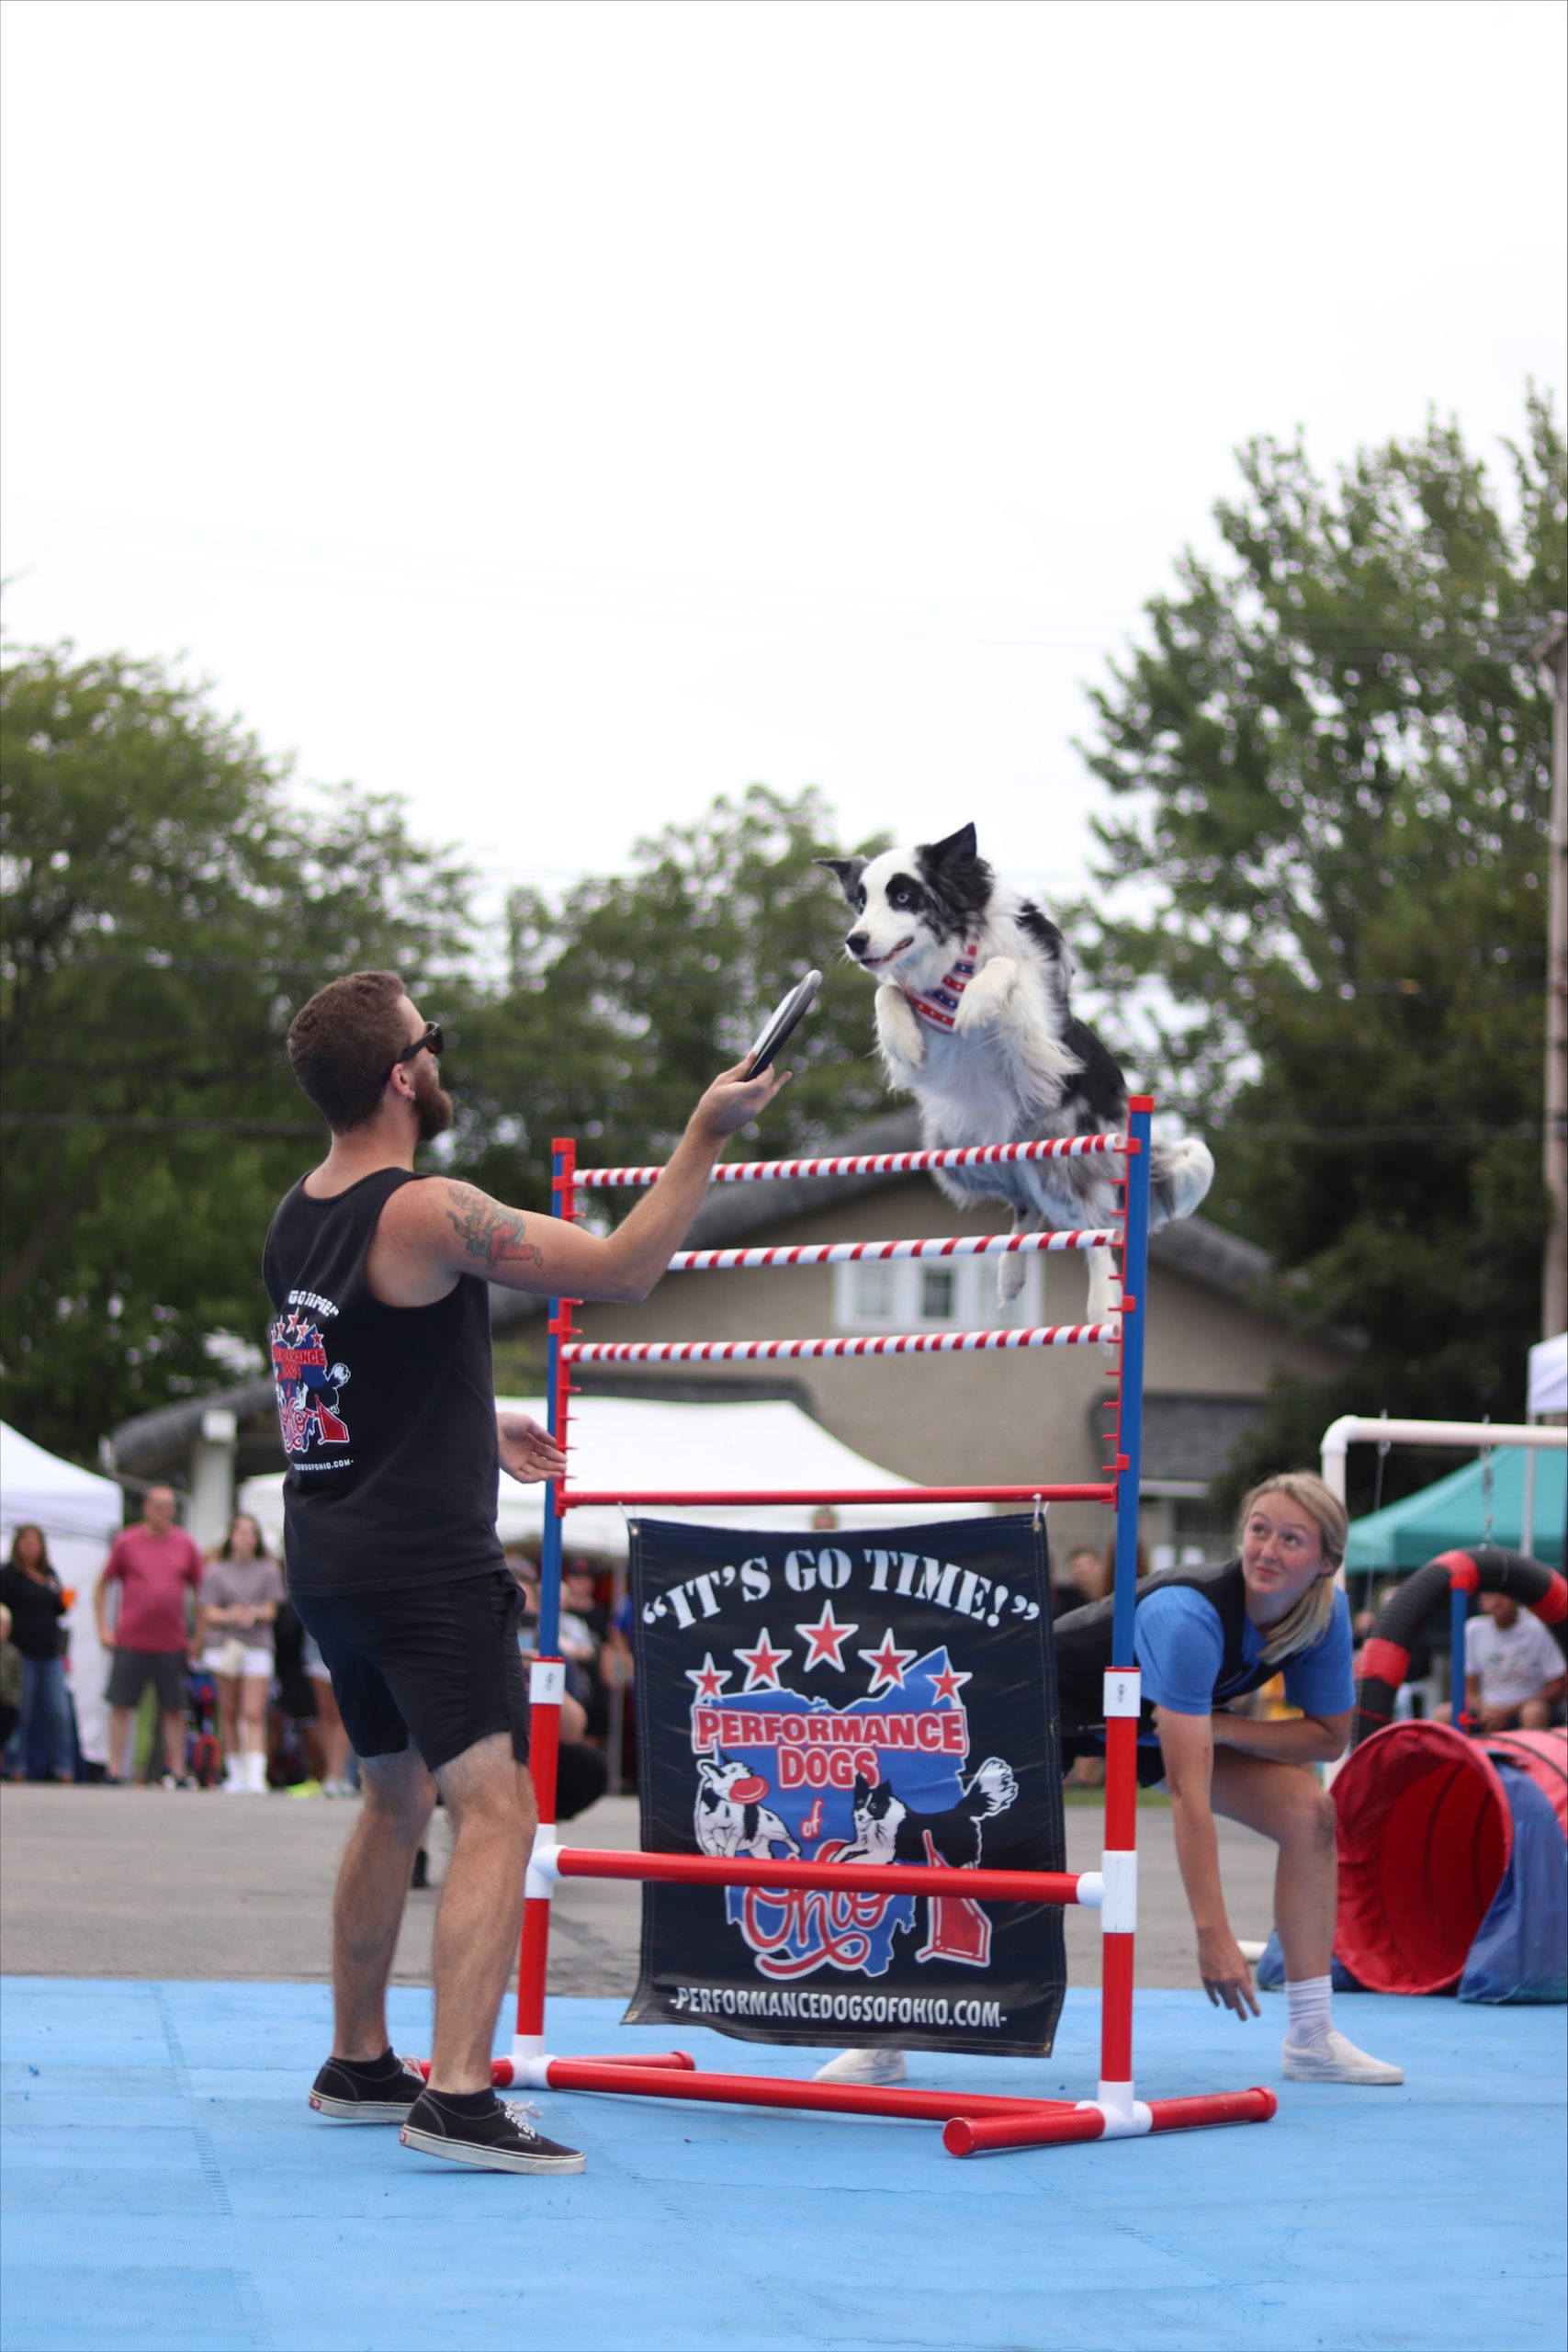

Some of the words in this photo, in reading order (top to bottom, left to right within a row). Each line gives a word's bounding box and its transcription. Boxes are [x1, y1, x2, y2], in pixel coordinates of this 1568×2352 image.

[784, 1547, 852, 1593] GO
[863, 1548, 1040, 1628] TIME!”
[694, 1706, 967, 1755] PERFORMANCE
[779, 1746, 880, 1789] DOGS
[800, 1797, 823, 1840] of
[742, 1839, 896, 1980] Ohio
[670, 1985, 1008, 2029] -PERFORMANCEDOGSOFOHIO.COM-
